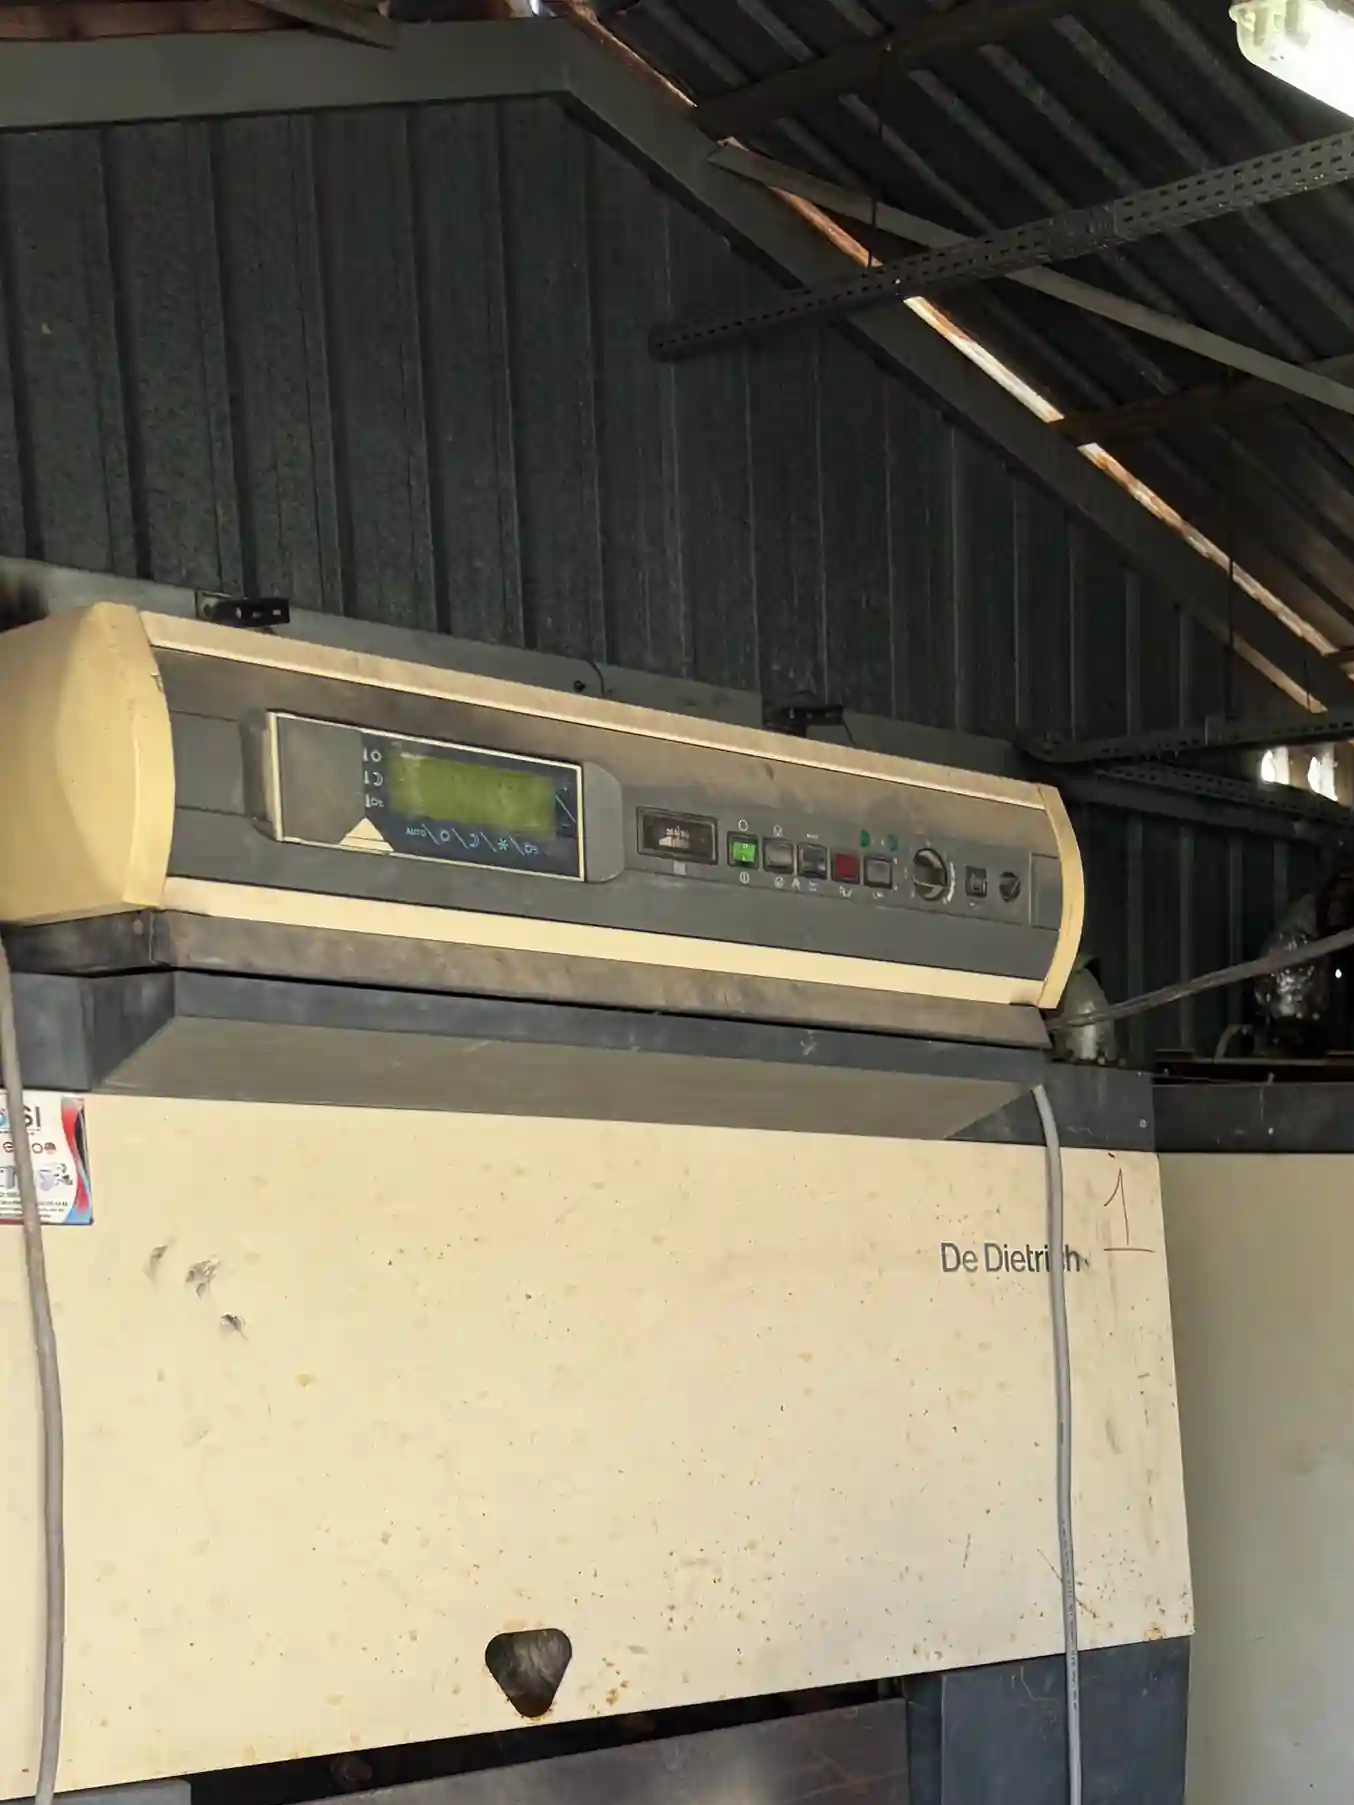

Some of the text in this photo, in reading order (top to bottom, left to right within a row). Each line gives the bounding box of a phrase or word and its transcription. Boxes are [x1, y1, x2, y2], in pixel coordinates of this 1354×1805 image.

[406, 827, 427, 838] AUTO
[940, 1242, 1080, 1273] De Dietrih
